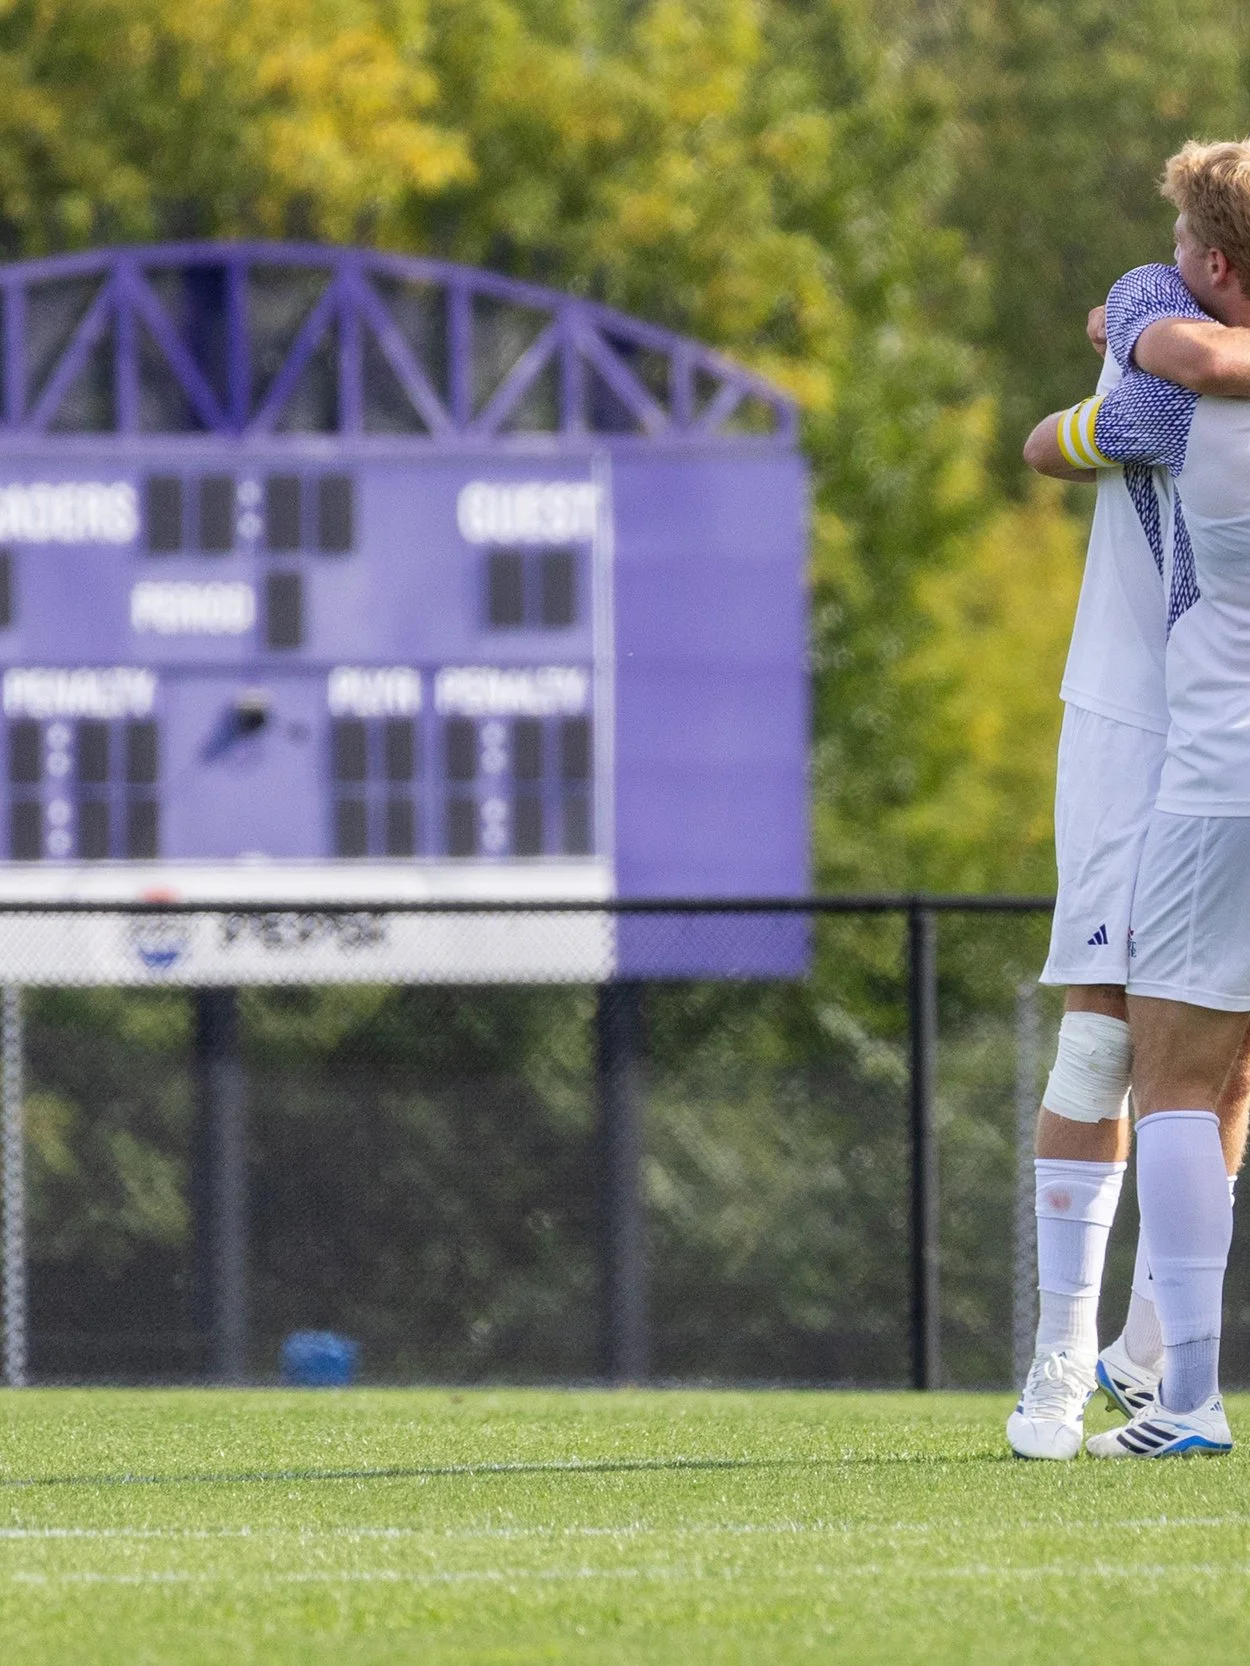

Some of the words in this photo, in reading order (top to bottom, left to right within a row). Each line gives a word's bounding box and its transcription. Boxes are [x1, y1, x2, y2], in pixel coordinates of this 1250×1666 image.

[458, 483, 600, 541] GUEST
[132, 583, 255, 632] PERIOD
[4, 669, 155, 716] PENALTY
[436, 668, 586, 715] PENALTY
